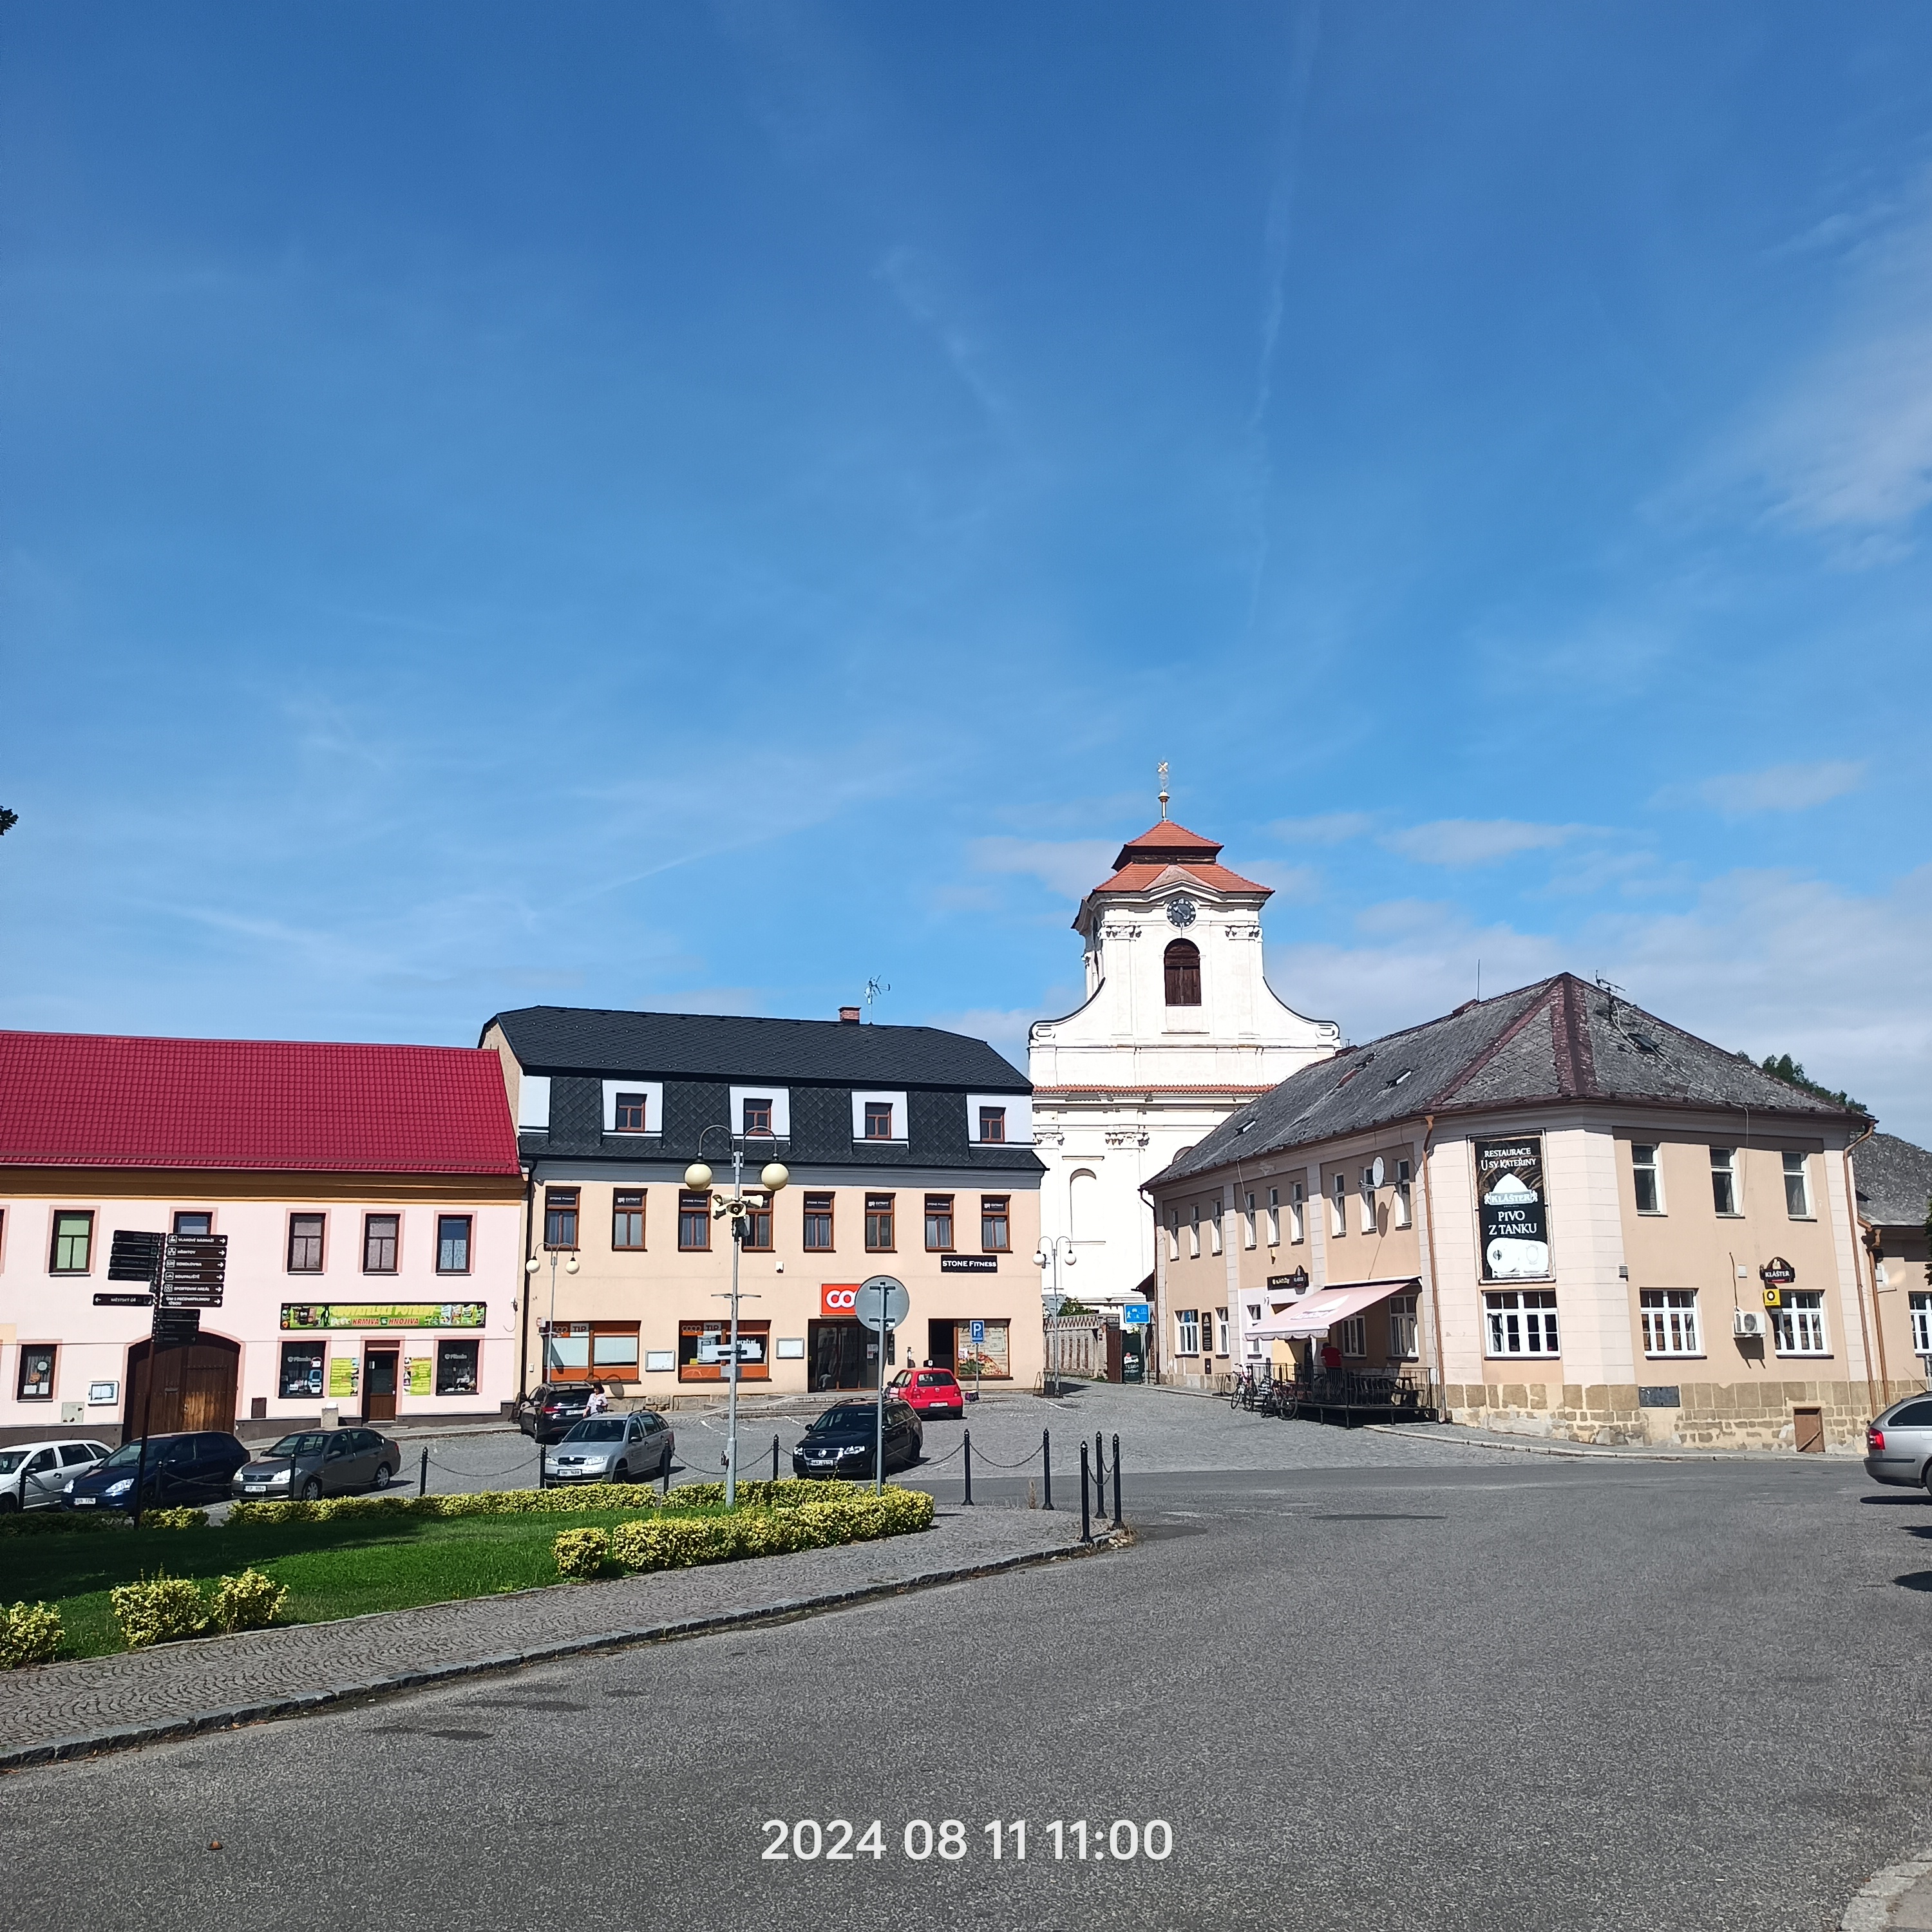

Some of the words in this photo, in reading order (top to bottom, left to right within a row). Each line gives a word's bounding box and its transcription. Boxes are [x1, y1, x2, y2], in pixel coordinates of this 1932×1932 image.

[1484, 1148, 1531, 1157] RESTAURACE
[1481, 1160, 1488, 1170] U
[1491, 1193, 1531, 1203] KLÁŠTER
[1498, 1211, 1525, 1221] PIVO
[1488, 1225, 1497, 1235] Z
[1499, 1224, 1537, 1234] TANKU
[973, 1323, 981, 1336] P
